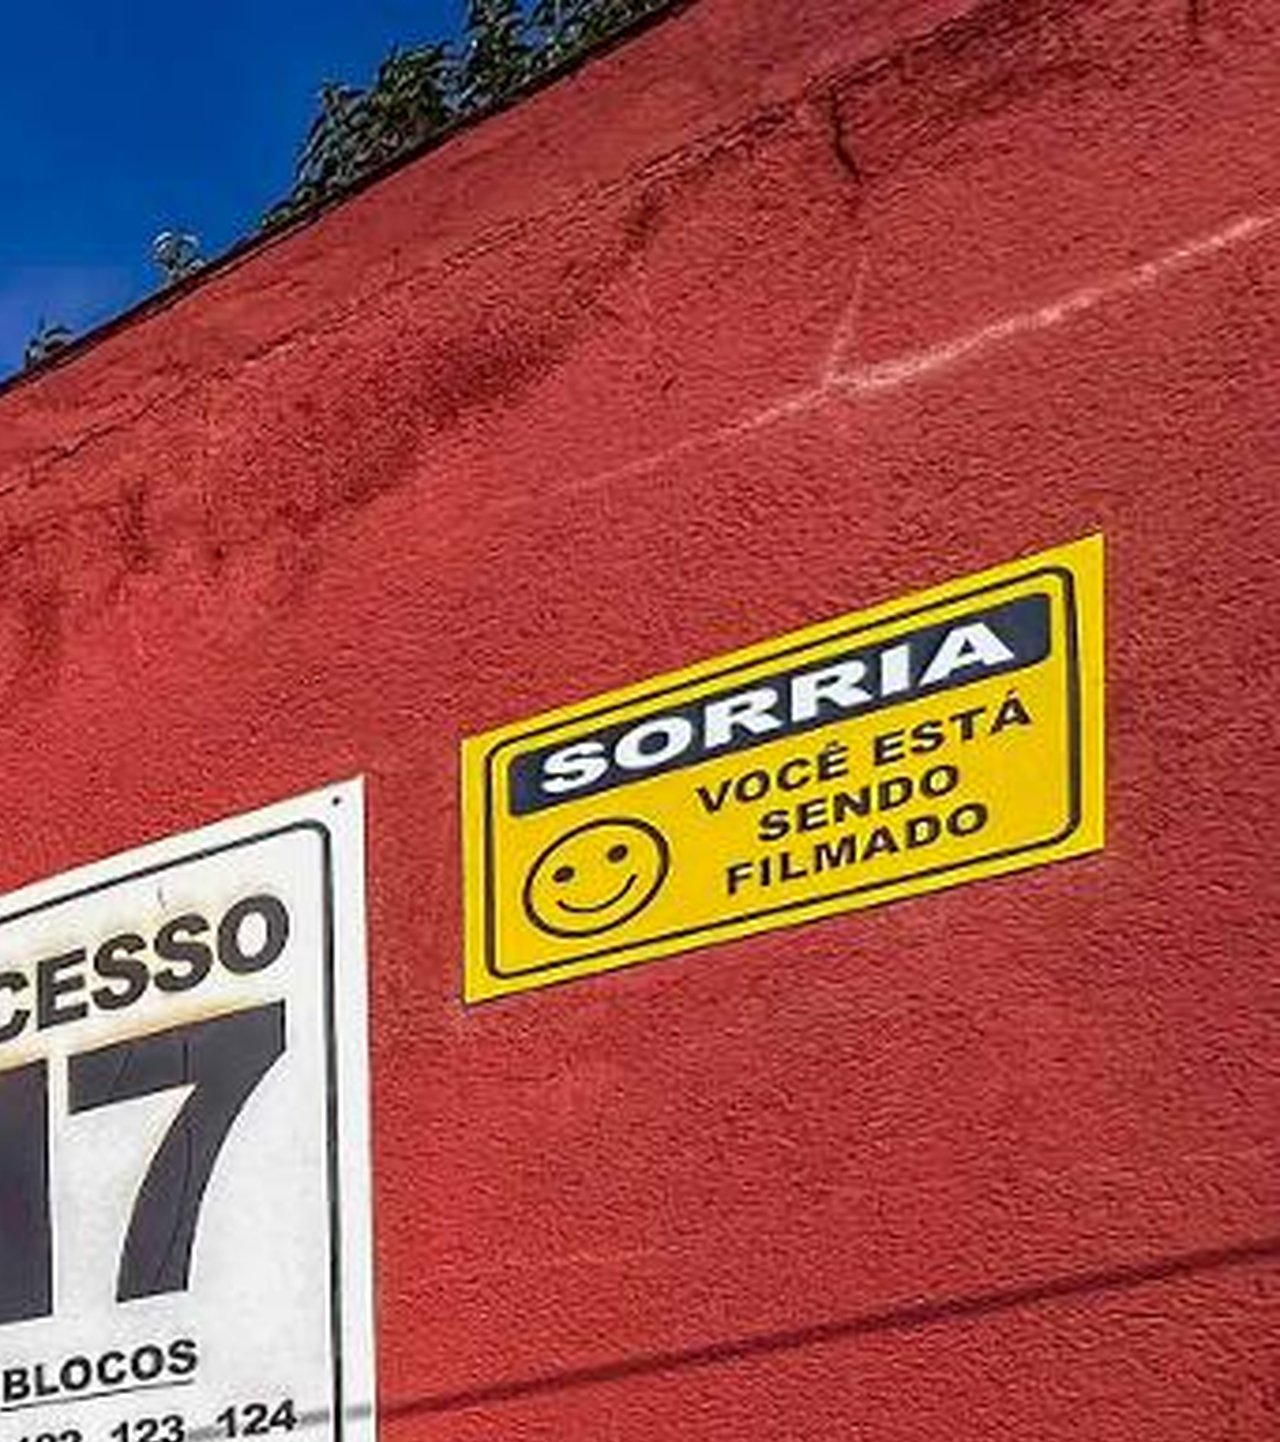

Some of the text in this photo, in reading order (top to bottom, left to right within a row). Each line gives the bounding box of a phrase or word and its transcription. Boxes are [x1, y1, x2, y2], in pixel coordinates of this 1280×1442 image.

[541, 621, 1015, 794] SORRIA
[694, 690, 1033, 815] VOCÊ ESTÁ
[757, 764, 960, 843] SENDO
[725, 802, 989, 896] FILMADO
[2, 1338, 198, 1402] BLOCOS
[216, 1399, 297, 1438] 124
